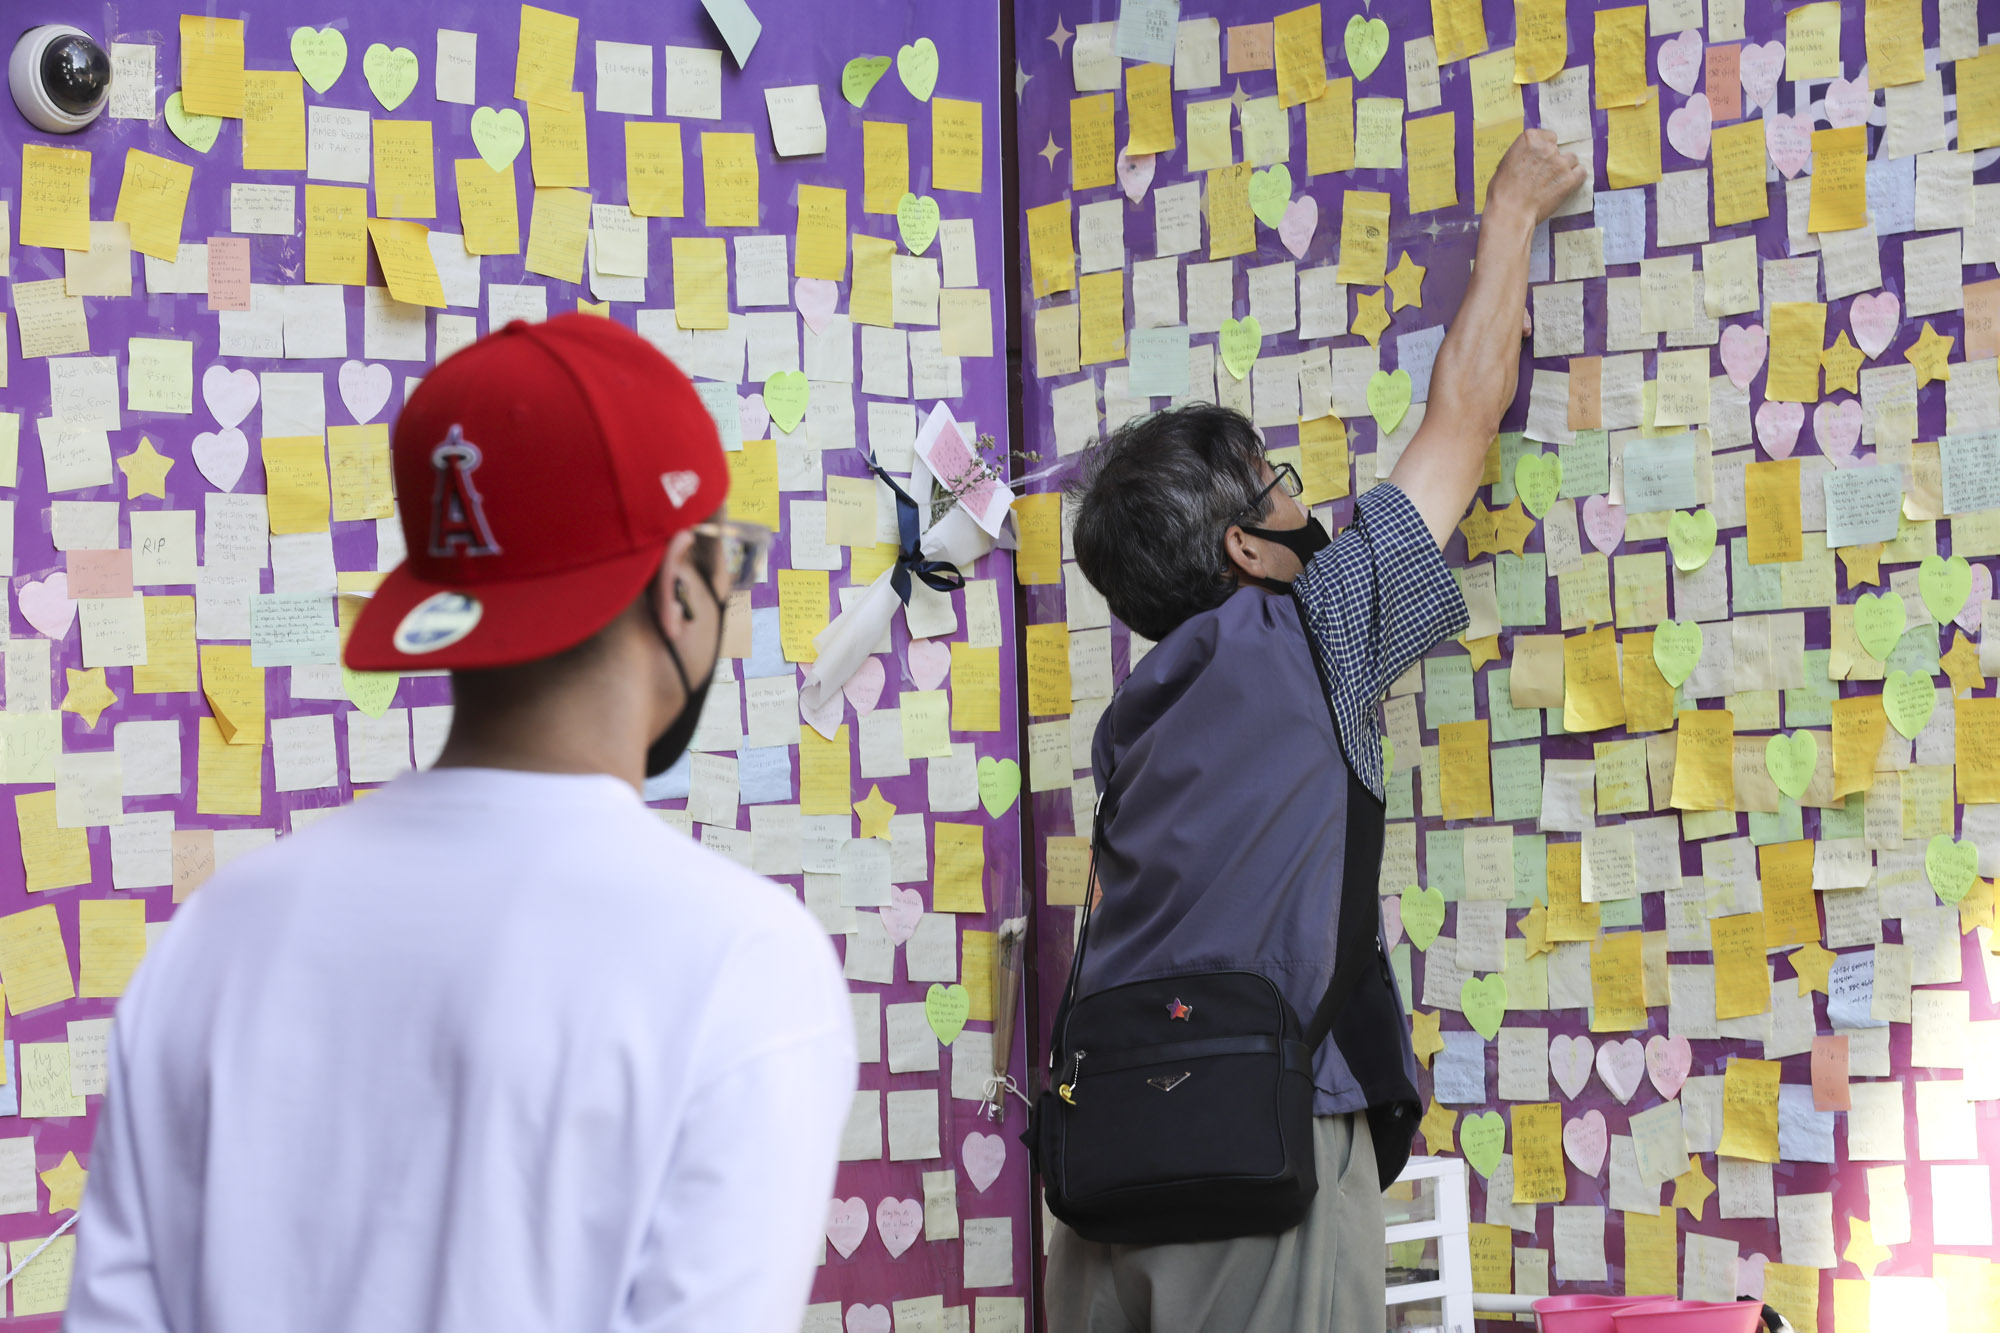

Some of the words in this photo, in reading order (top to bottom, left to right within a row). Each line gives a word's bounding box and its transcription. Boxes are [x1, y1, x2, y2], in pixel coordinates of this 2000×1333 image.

[312, 111, 331, 125] QUE
[335, 116, 352, 125] VOS
[142, 537, 166, 556] RIP
[27, 1067, 60, 1094] high
